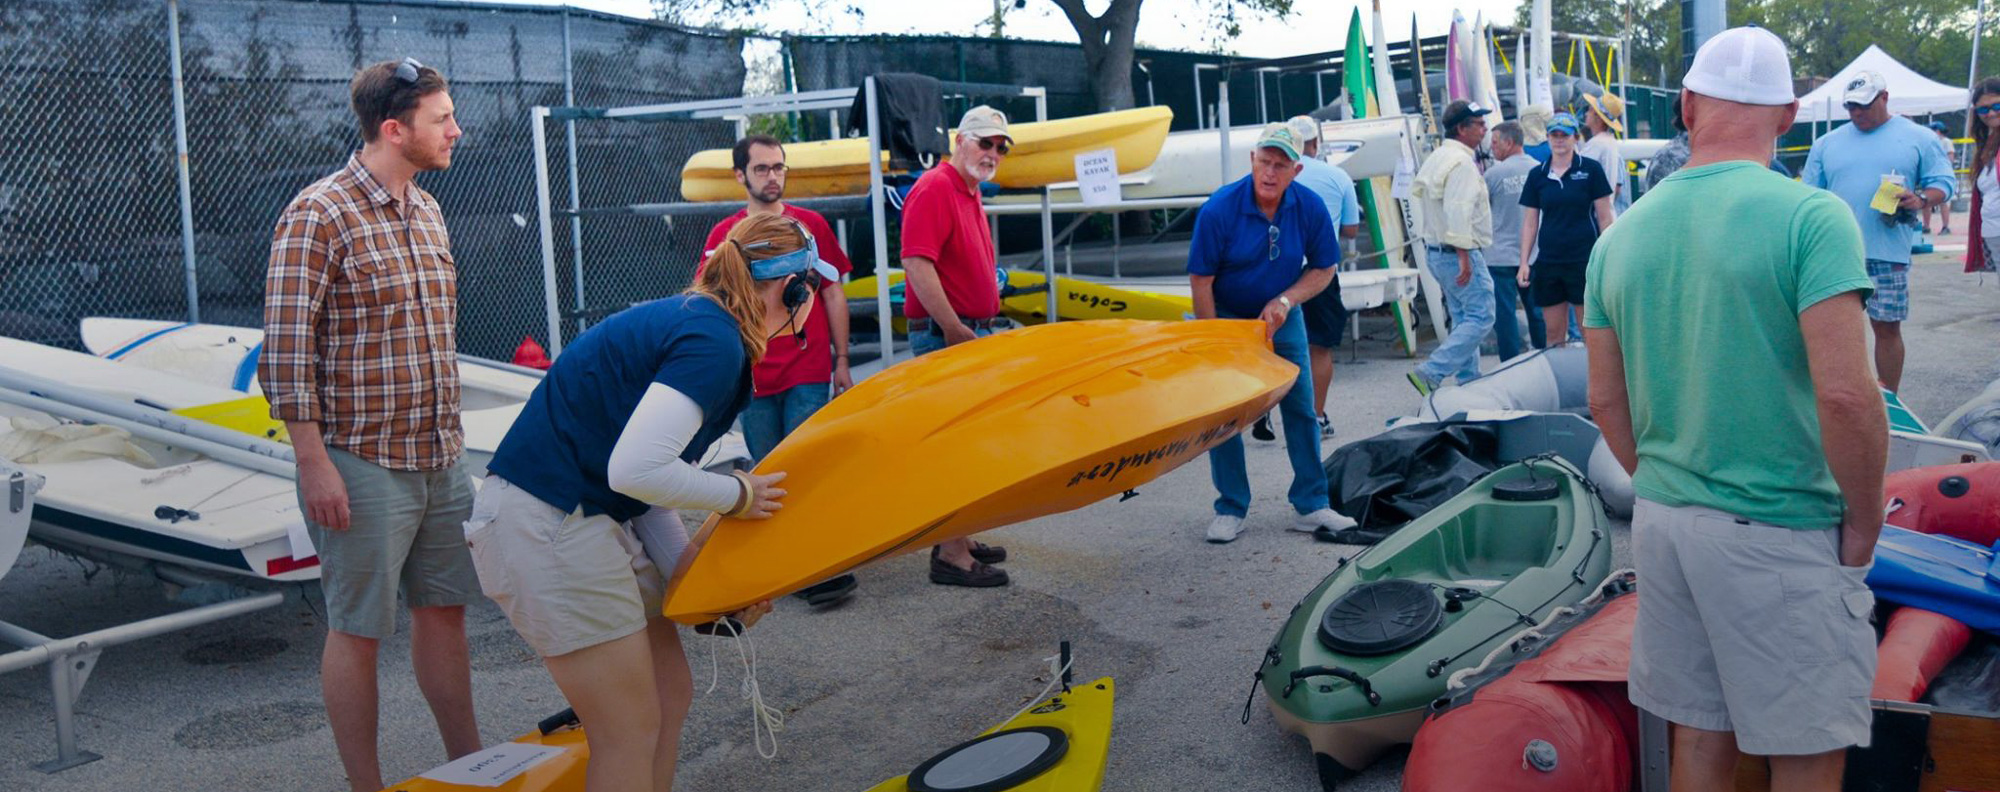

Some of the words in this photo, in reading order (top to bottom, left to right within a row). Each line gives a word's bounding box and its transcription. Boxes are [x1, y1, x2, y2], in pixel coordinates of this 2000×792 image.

[1083, 157, 1107, 166] OCEAN
[1084, 166, 1109, 175] KAYAK
[1068, 291, 1127, 312] Cobra
